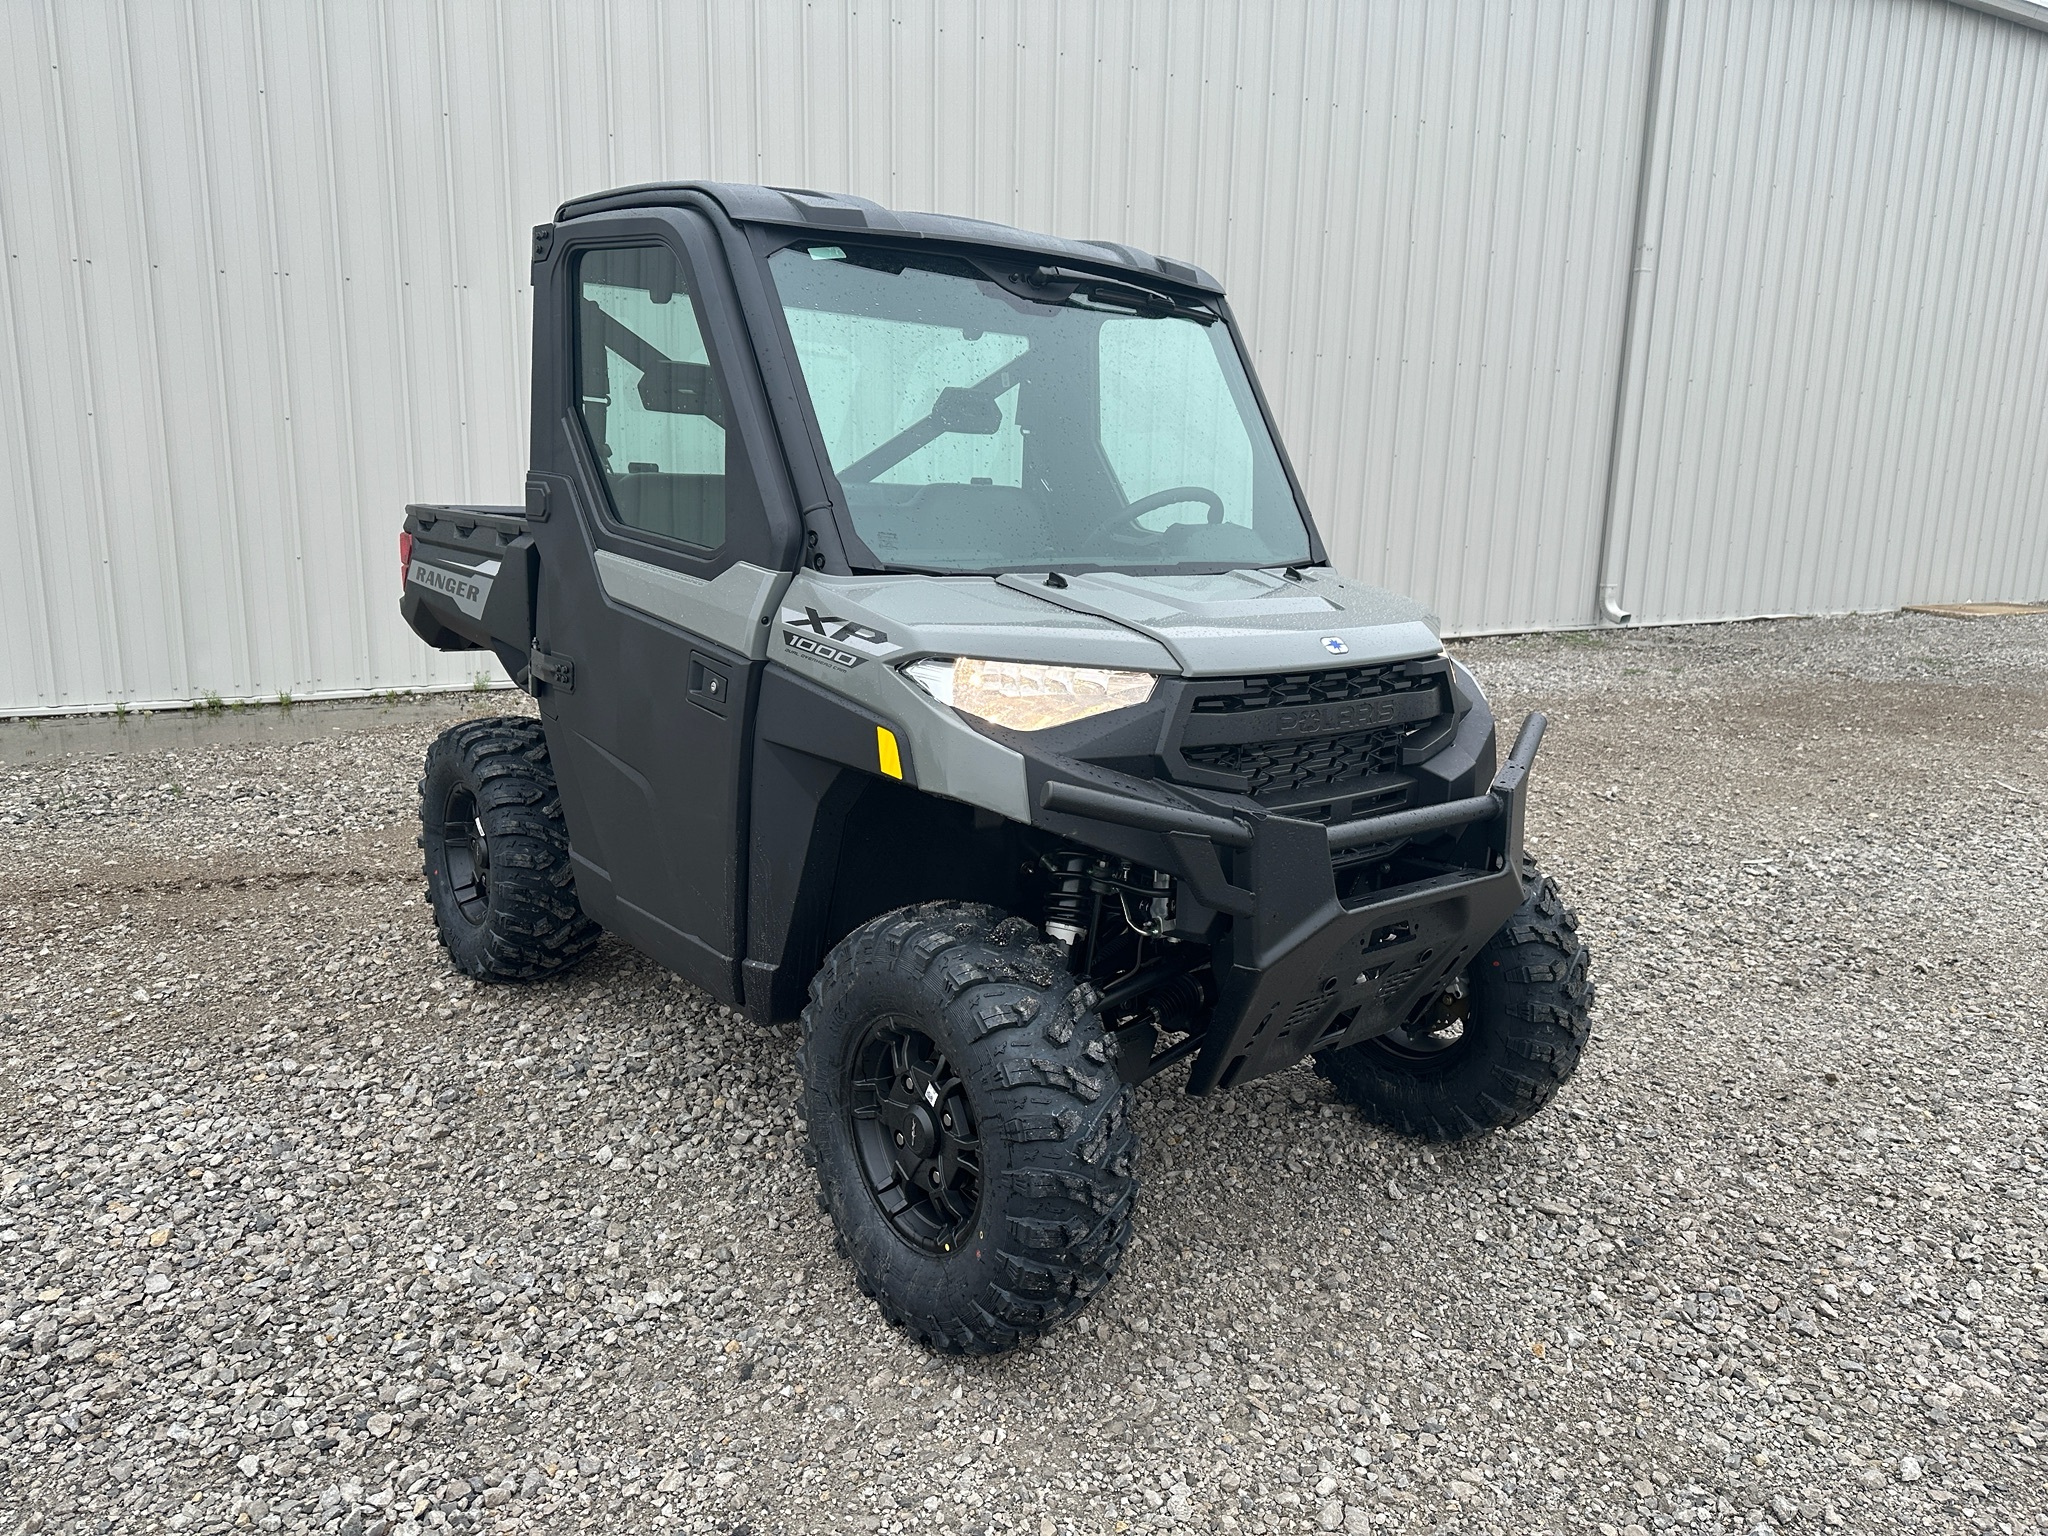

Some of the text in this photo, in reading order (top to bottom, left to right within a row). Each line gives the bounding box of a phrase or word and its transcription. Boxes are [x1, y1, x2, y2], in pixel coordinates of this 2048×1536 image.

[416, 566, 480, 602] RANGER
[784, 606, 888, 645] XP
[784, 648, 848, 674] DUAL OVERHEAD CAM
[789, 634, 857, 667] 1000
[1276, 700, 1395, 737] POLARIS
